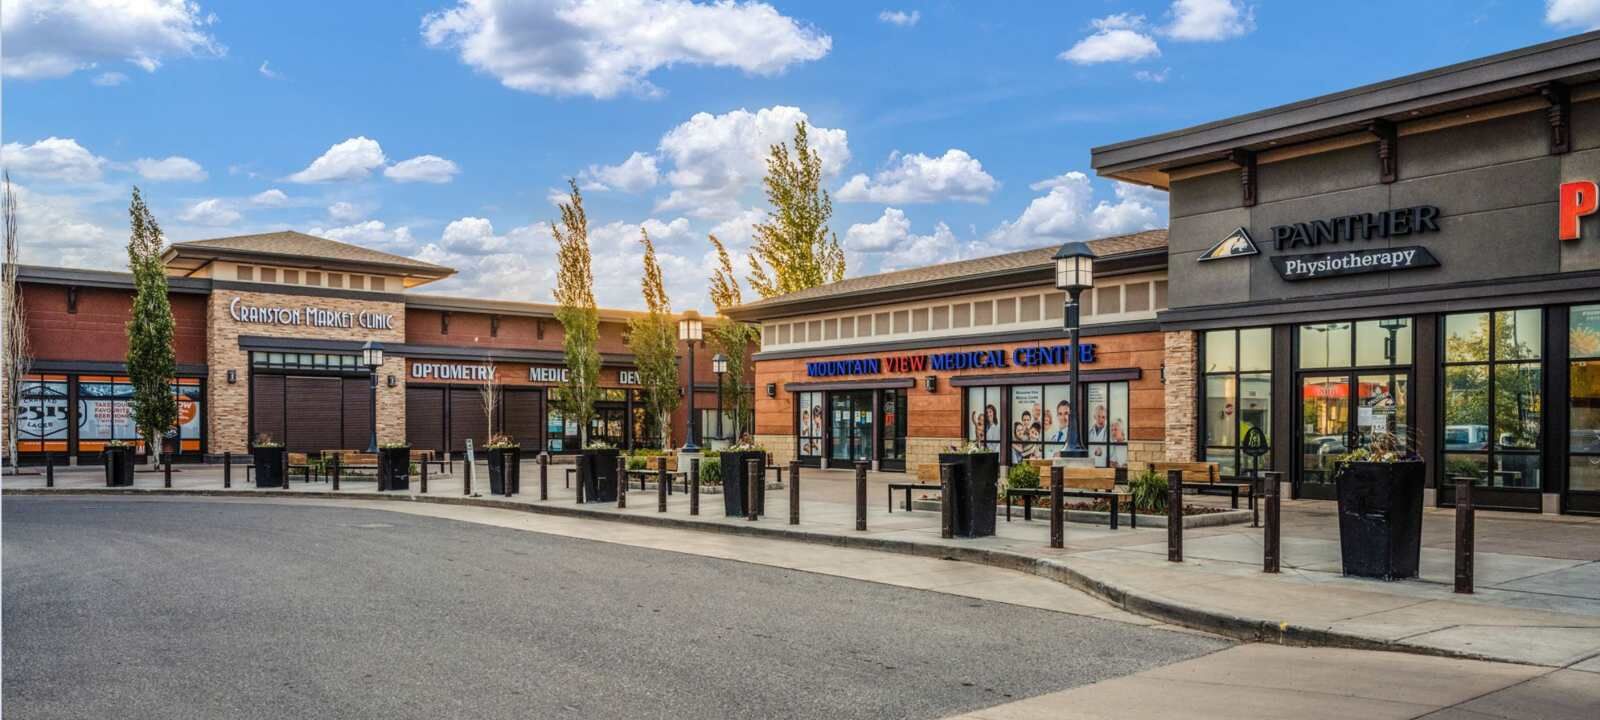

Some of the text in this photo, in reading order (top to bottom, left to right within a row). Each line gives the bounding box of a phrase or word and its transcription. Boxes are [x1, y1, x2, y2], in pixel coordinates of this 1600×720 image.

[1270, 204, 1440, 250] PANTHER
[1285, 250, 1416, 276] Physiotherapy
[230, 296, 393, 330] CRANSTON MARKET CLINIC
[412, 362, 497, 381] OPTOMETRY
[806, 343, 1096, 377] MOUNTAIN VIEW MEDICAL CENTE
